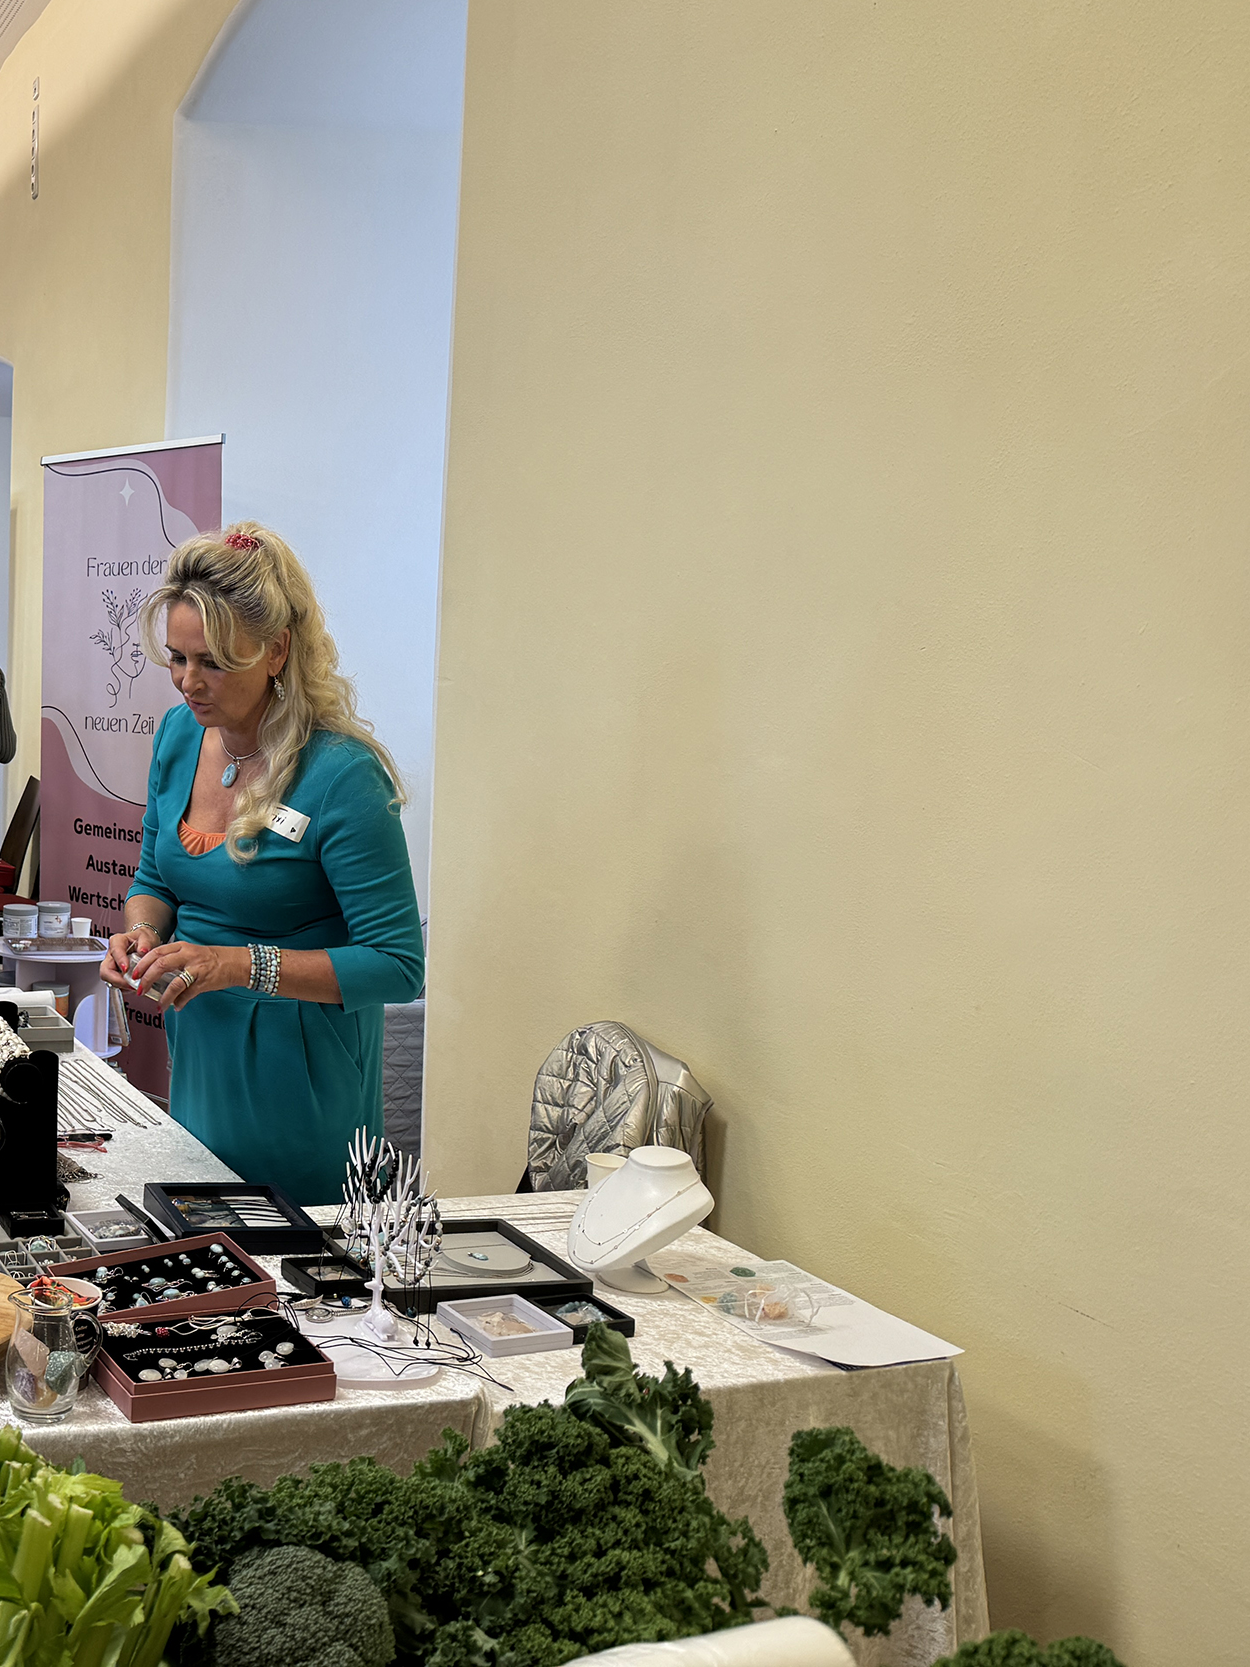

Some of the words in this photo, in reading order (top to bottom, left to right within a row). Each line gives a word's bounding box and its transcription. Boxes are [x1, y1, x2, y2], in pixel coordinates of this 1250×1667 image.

[86, 557, 139, 577] Frauen
[141, 554, 167, 576] der
[84, 716, 129, 733] neuen
[73, 818, 144, 844] Gemeinsc
[85, 854, 140, 878] Austau
[68, 885, 125, 911] Wertsch
[123, 1001, 166, 1030] freud
